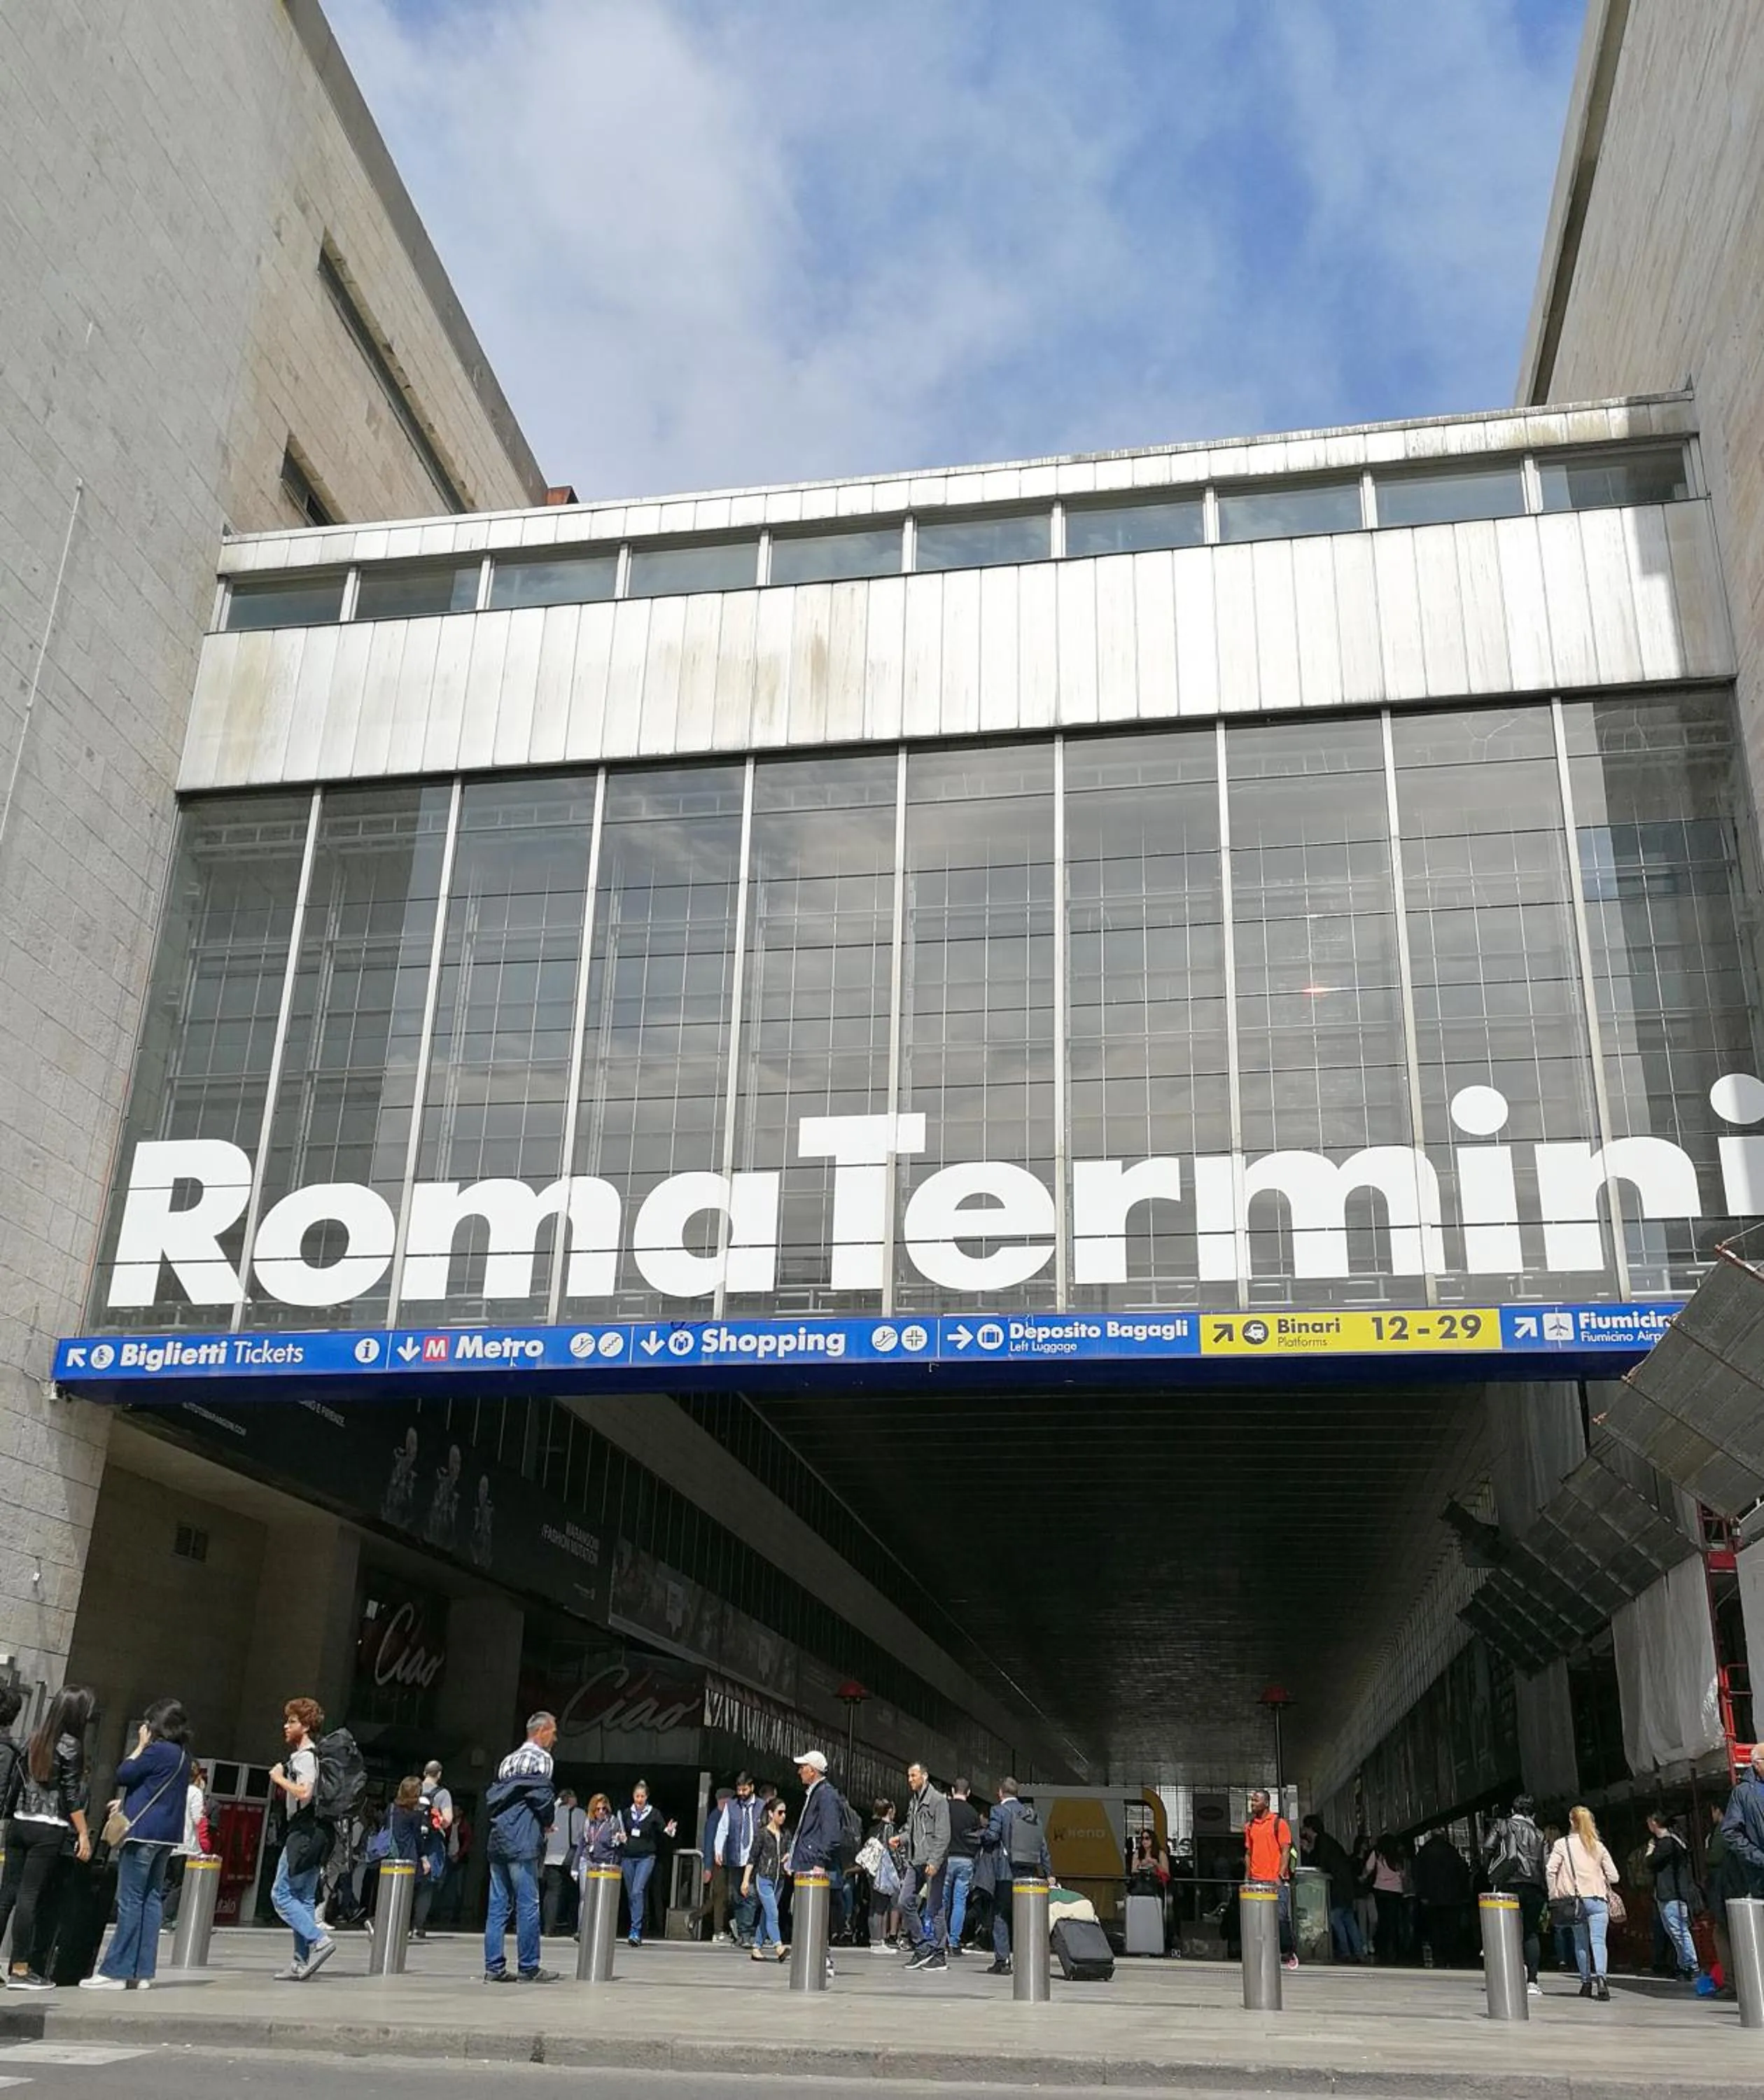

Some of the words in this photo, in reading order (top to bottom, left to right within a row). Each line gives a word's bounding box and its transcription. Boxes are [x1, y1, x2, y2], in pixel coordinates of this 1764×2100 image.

[1009, 1321, 1101, 1340] Deposito
[1107, 1320, 1188, 1341] Bagagli
[1278, 1317, 1340, 1334] Binari
[1581, 1331, 1634, 1343] Fiumicino
[1637, 1330, 1666, 1343] Airp
[455, 1335, 544, 1359] Metro
[701, 1326, 846, 1359] Shopping
[1010, 1341, 1029, 1352] Left
[1032, 1340, 1077, 1354] Luggage
[1278, 1336, 1328, 1348] Platforms
[120, 1340, 227, 1372] Biglietti
[234, 1339, 304, 1364] Tickets
[373, 1601, 446, 1688] Ciao
[557, 1663, 701, 1737] Ciao
